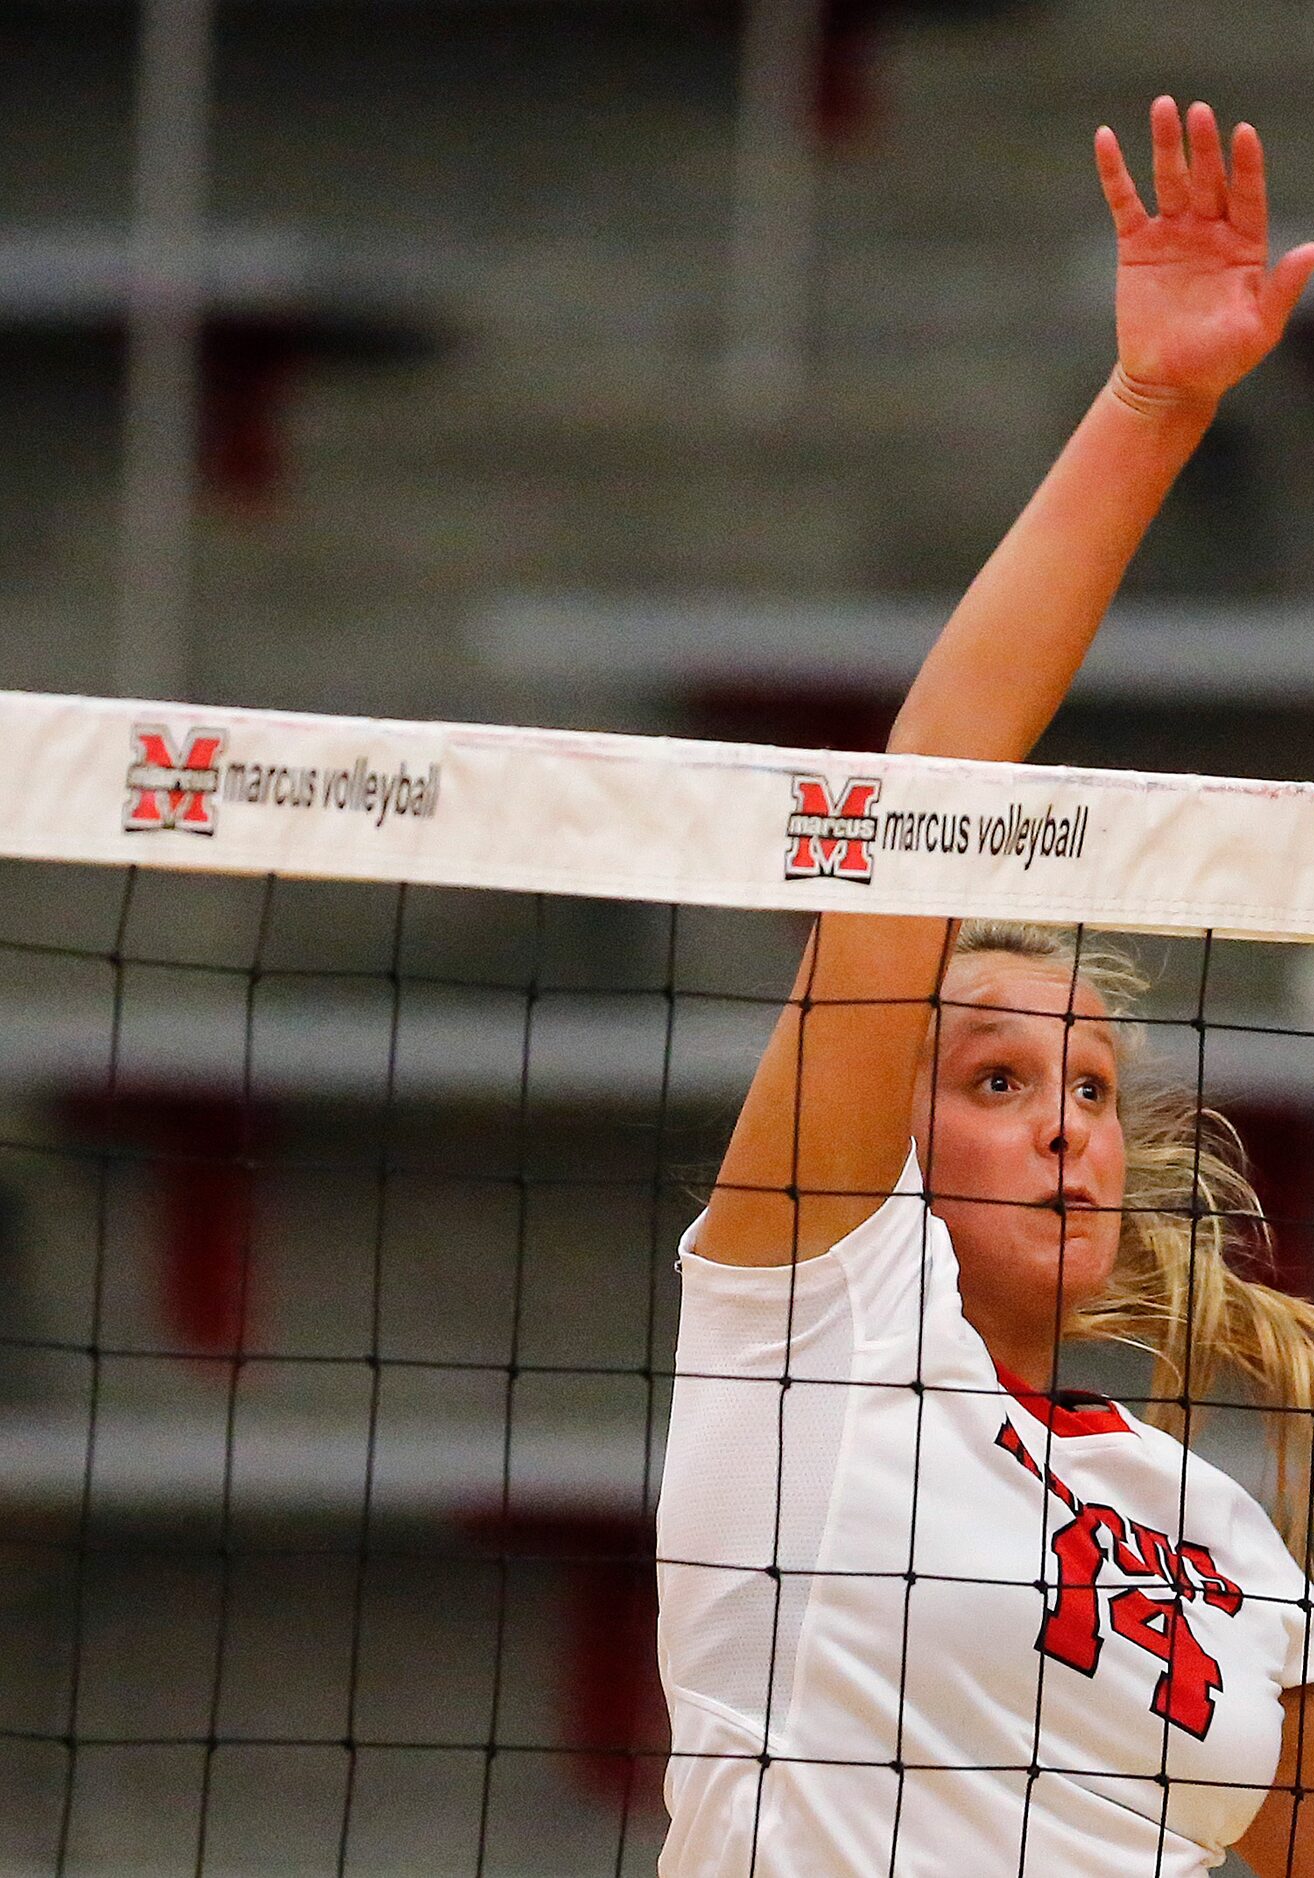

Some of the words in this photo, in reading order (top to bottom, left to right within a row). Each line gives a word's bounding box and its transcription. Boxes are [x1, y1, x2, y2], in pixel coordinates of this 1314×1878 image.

[224, 762, 317, 807] marcus
[323, 756, 441, 828] volleyball
[789, 815, 876, 840] marcus
[882, 811, 970, 854] marcus
[978, 803, 1089, 871] volleyball
[1033, 1513, 1223, 1742] 14
